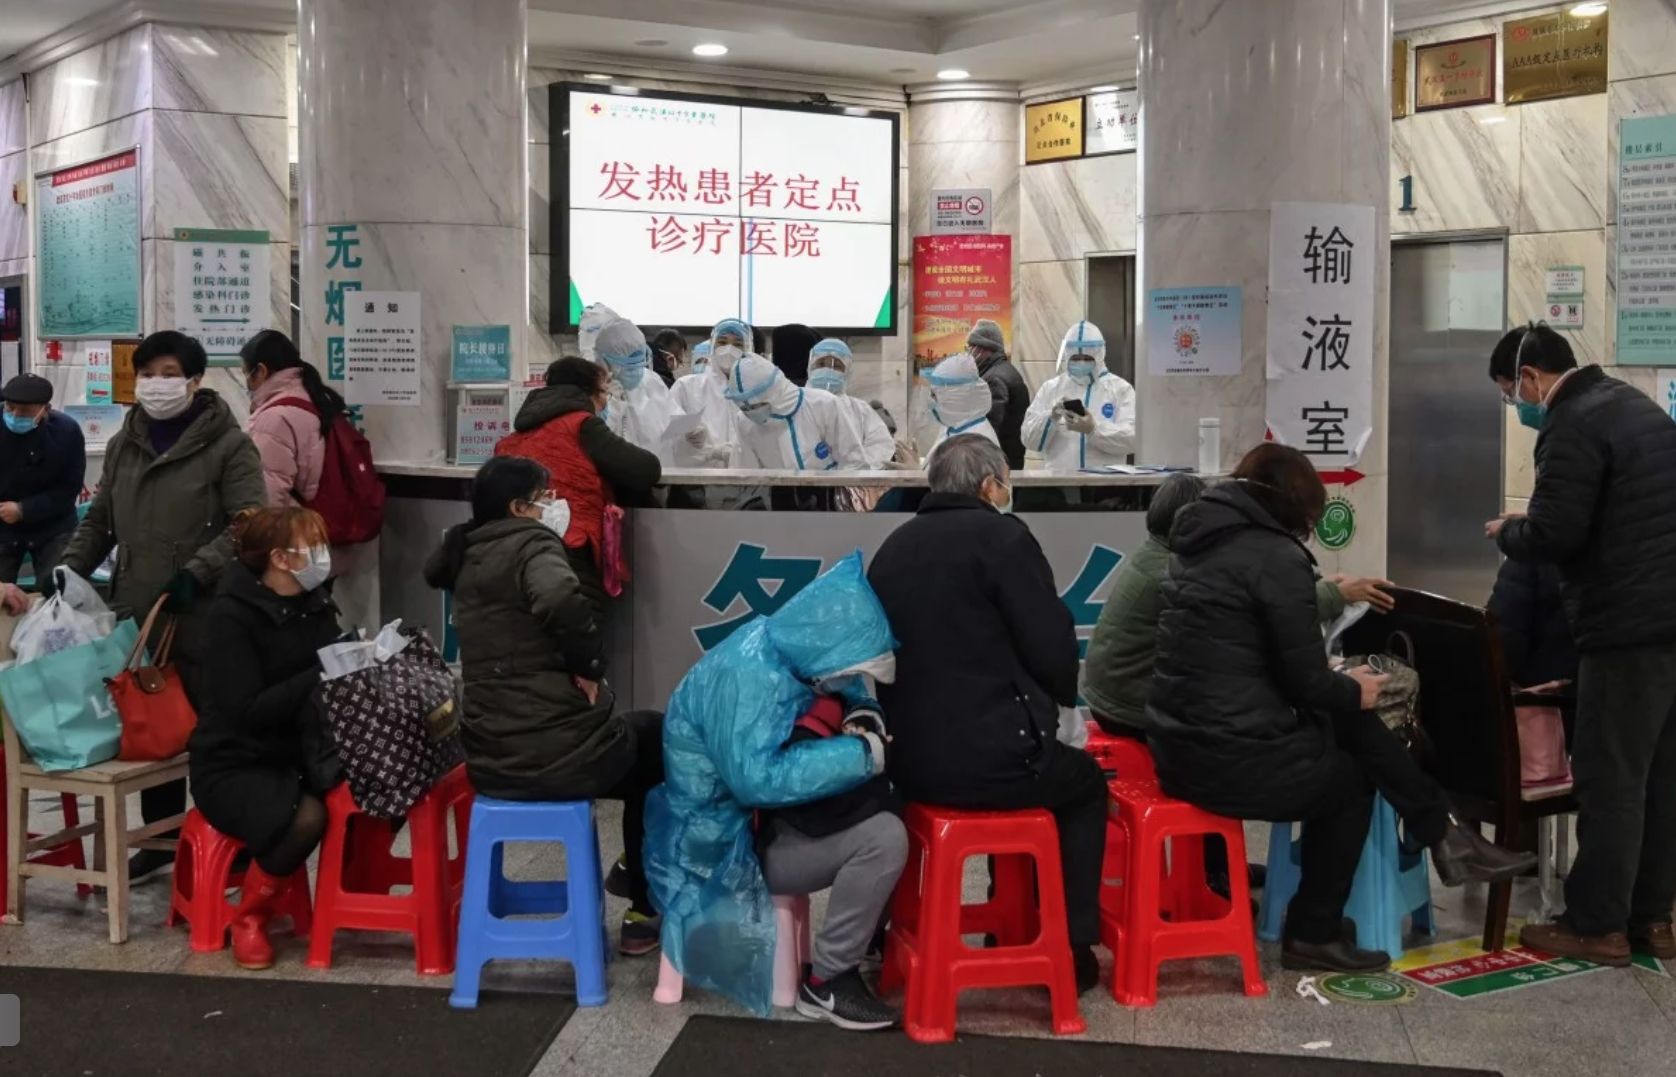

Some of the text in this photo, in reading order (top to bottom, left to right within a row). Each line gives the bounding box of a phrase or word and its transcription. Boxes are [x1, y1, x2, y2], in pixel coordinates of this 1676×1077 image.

[598, 161, 862, 213] 发热患者定点
[1398, 175, 1417, 212] 1
[646, 215, 821, 258] 诊疗医院
[193, 275, 250, 287] 住院部通道
[192, 290, 250, 301] 感染科门诊
[364, 301, 399, 314] 通知
[192, 303, 250, 314] 发热门诊
[1301, 226, 1354, 456] 输液室
